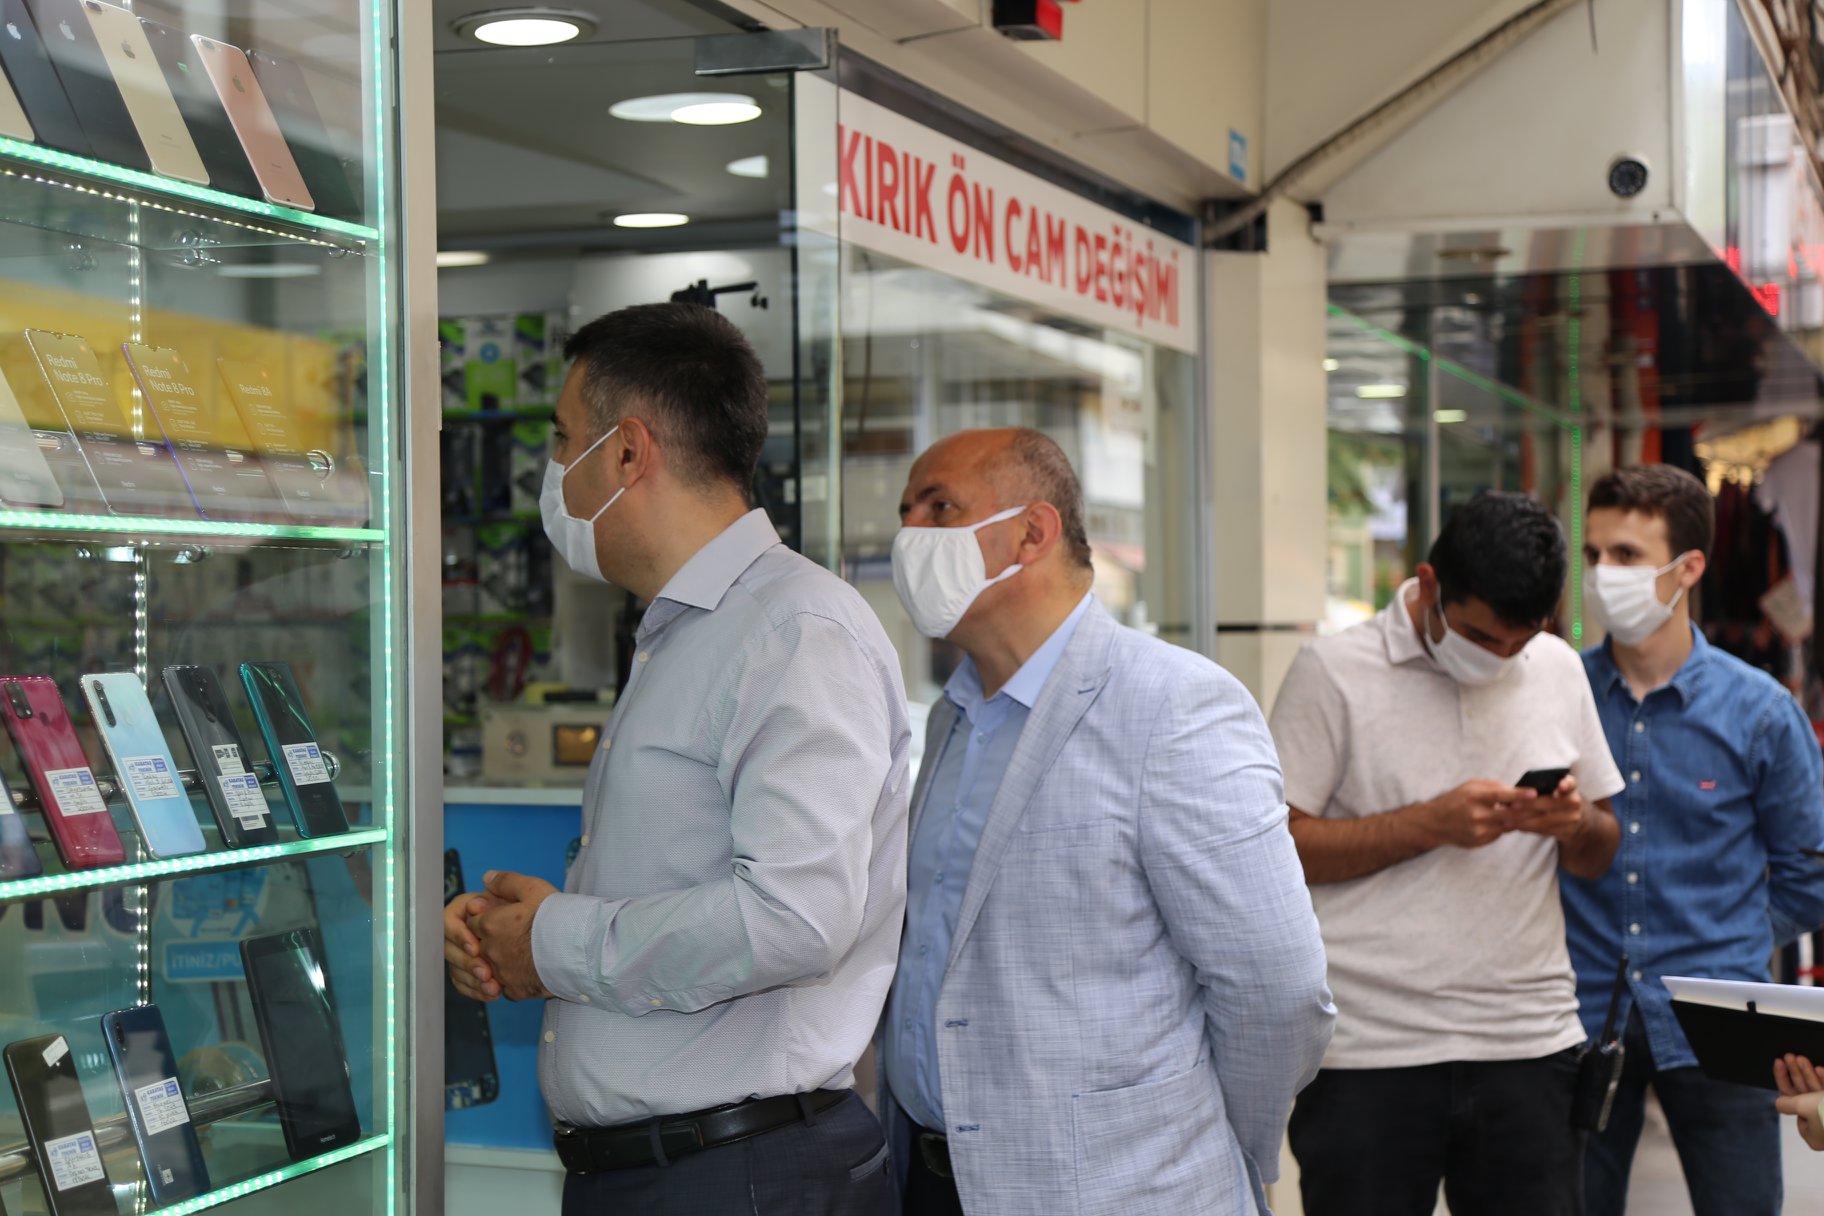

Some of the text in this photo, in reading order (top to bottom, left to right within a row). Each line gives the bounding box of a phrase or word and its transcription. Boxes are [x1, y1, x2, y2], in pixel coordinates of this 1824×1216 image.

[838, 124, 1179, 328] KIRIK ÖN CAM DEĞİŞİMİ
[46, 353, 78, 369] Redmi
[53, 369, 103, 387] Note 8 Pro
[142, 365, 171, 379] Redmi
[149, 379, 195, 397] Note 8 Pro
[239, 383, 262, 396] Redmi
